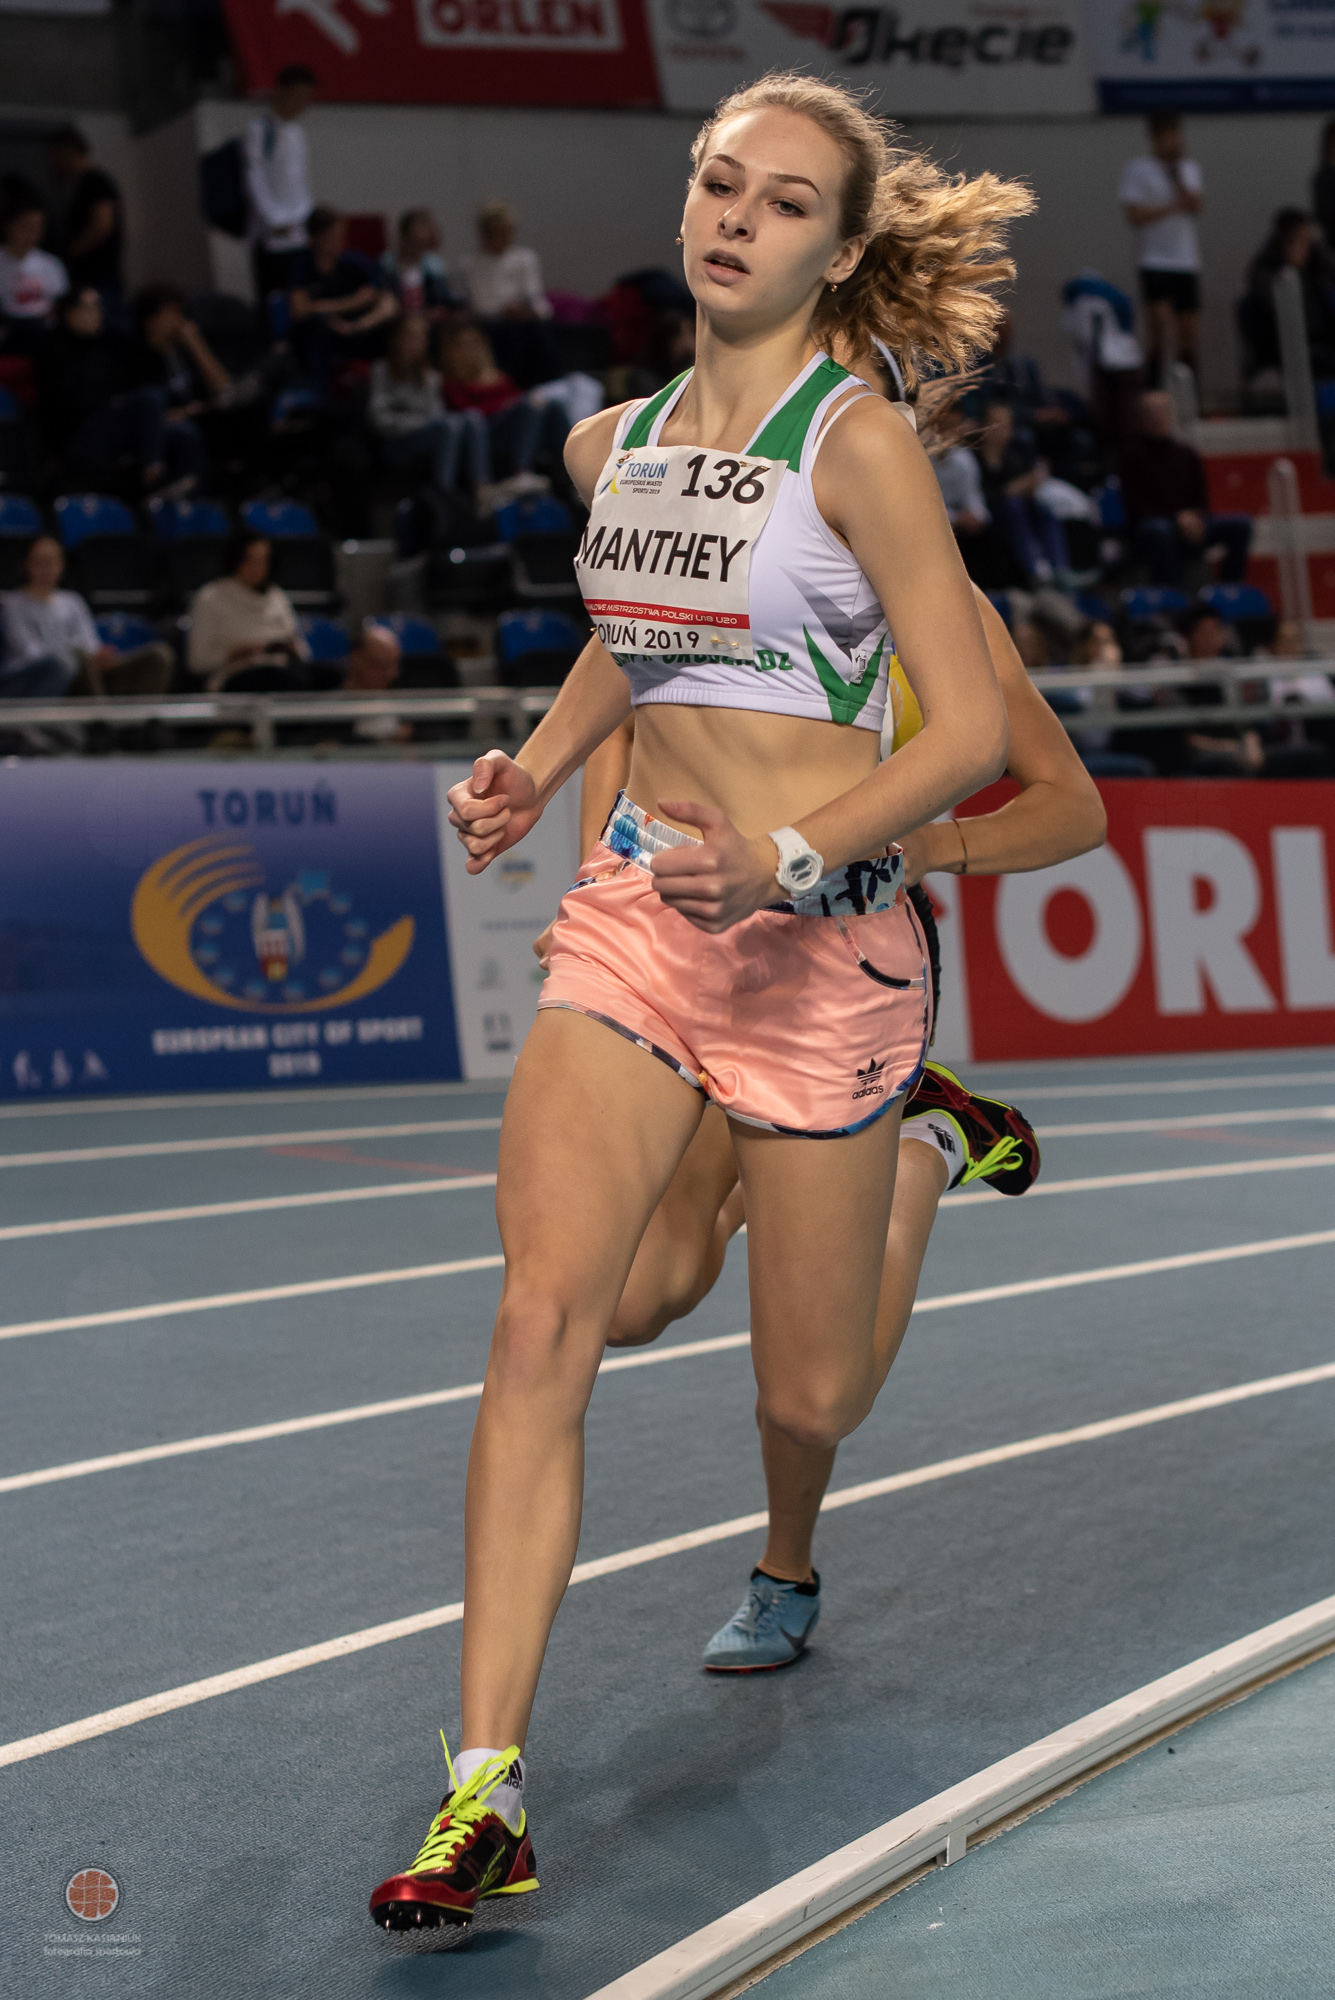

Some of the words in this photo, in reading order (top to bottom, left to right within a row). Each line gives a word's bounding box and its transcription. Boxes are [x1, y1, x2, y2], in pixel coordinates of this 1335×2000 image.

[625, 458, 669, 479] TORUŃ
[681, 453, 771, 504] 136
[576, 525, 748, 582] MANTHEY
[607, 604, 660, 617] MISTRZOSTWA
[661, 610, 693, 621] POLSKI
[695, 614, 714, 623] U18
[715, 616, 738, 625] U20
[644, 628, 700, 650] 2019
[197, 778, 337, 826] TORUŃ
[851, 1085, 884, 1100] adidas
